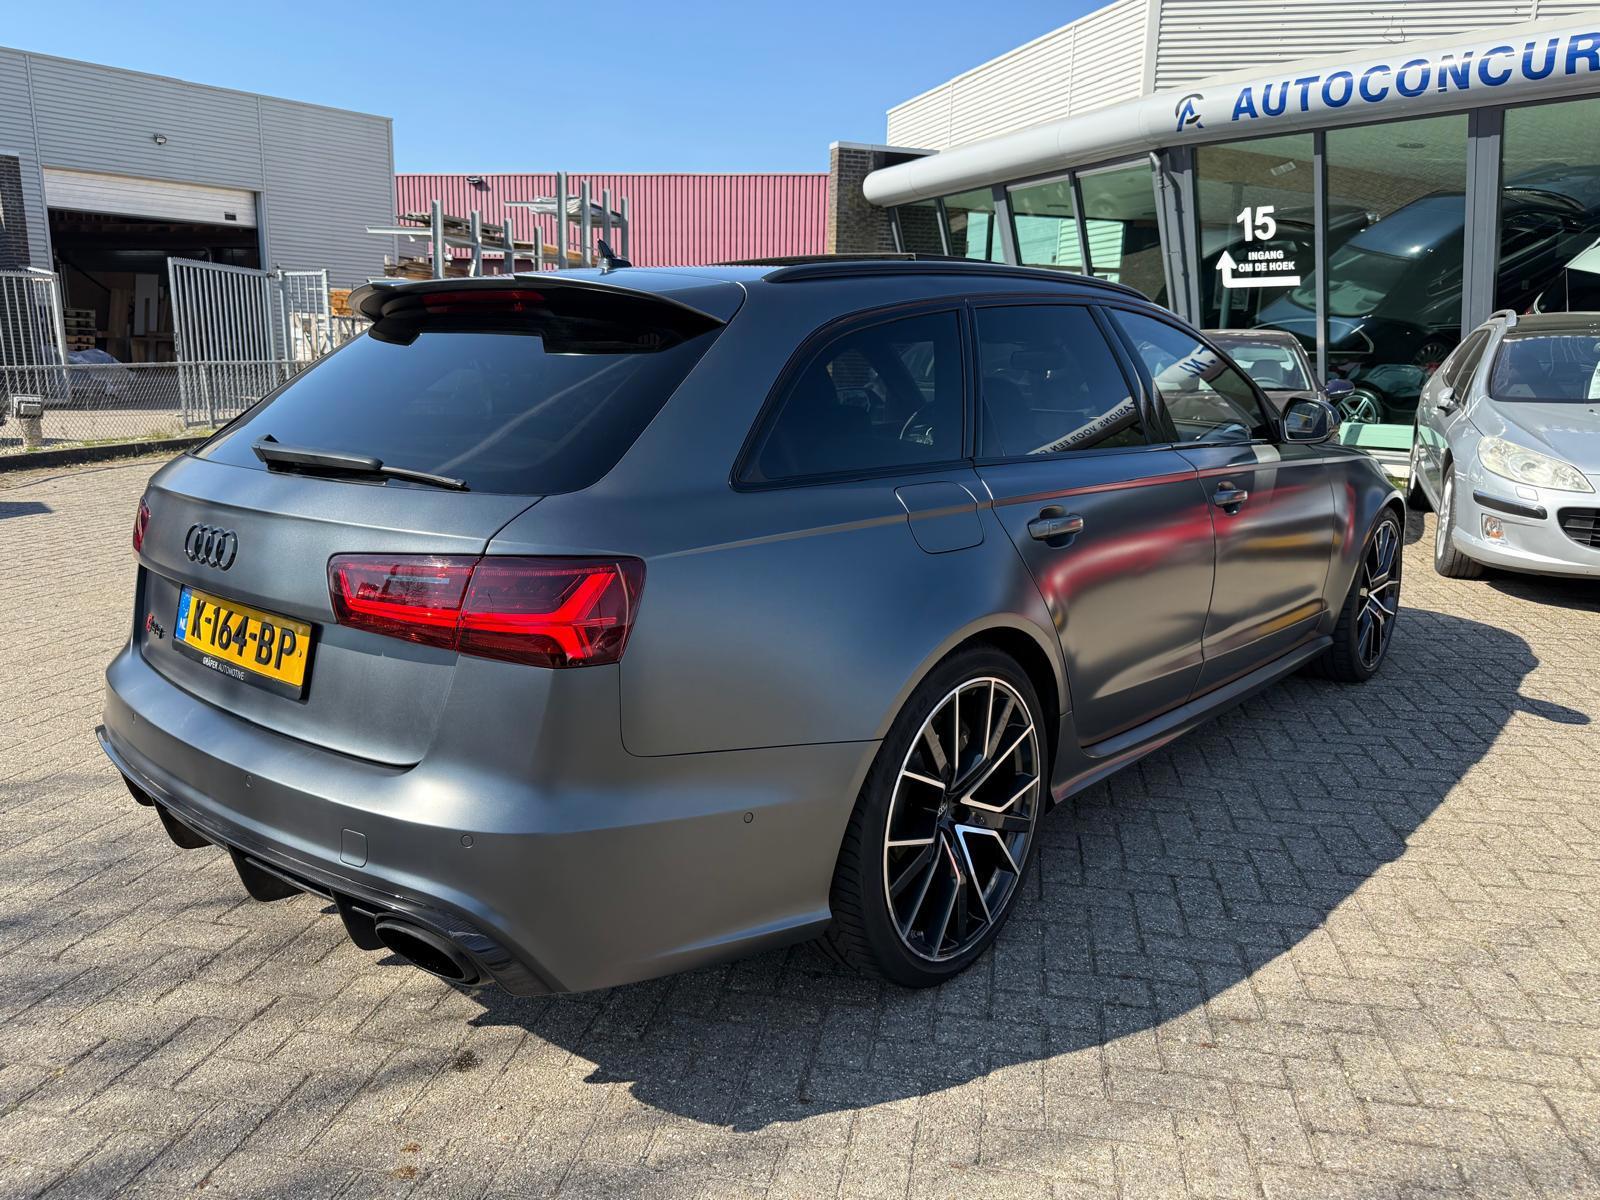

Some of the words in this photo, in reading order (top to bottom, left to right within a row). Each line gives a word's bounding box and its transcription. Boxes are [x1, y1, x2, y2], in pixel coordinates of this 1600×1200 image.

[1231, 32, 1600, 121] AUTOCONCUR
[1236, 205, 1277, 241] 15
[1238, 263, 1253, 273] OM
[1255, 262, 1267, 272] DE
[1269, 261, 1295, 271] HOEK
[1248, 250, 1284, 261] INGANG
[191, 599, 297, 670] K-164-BP
[218, 663, 245, 680] AUTOMOTIVE
